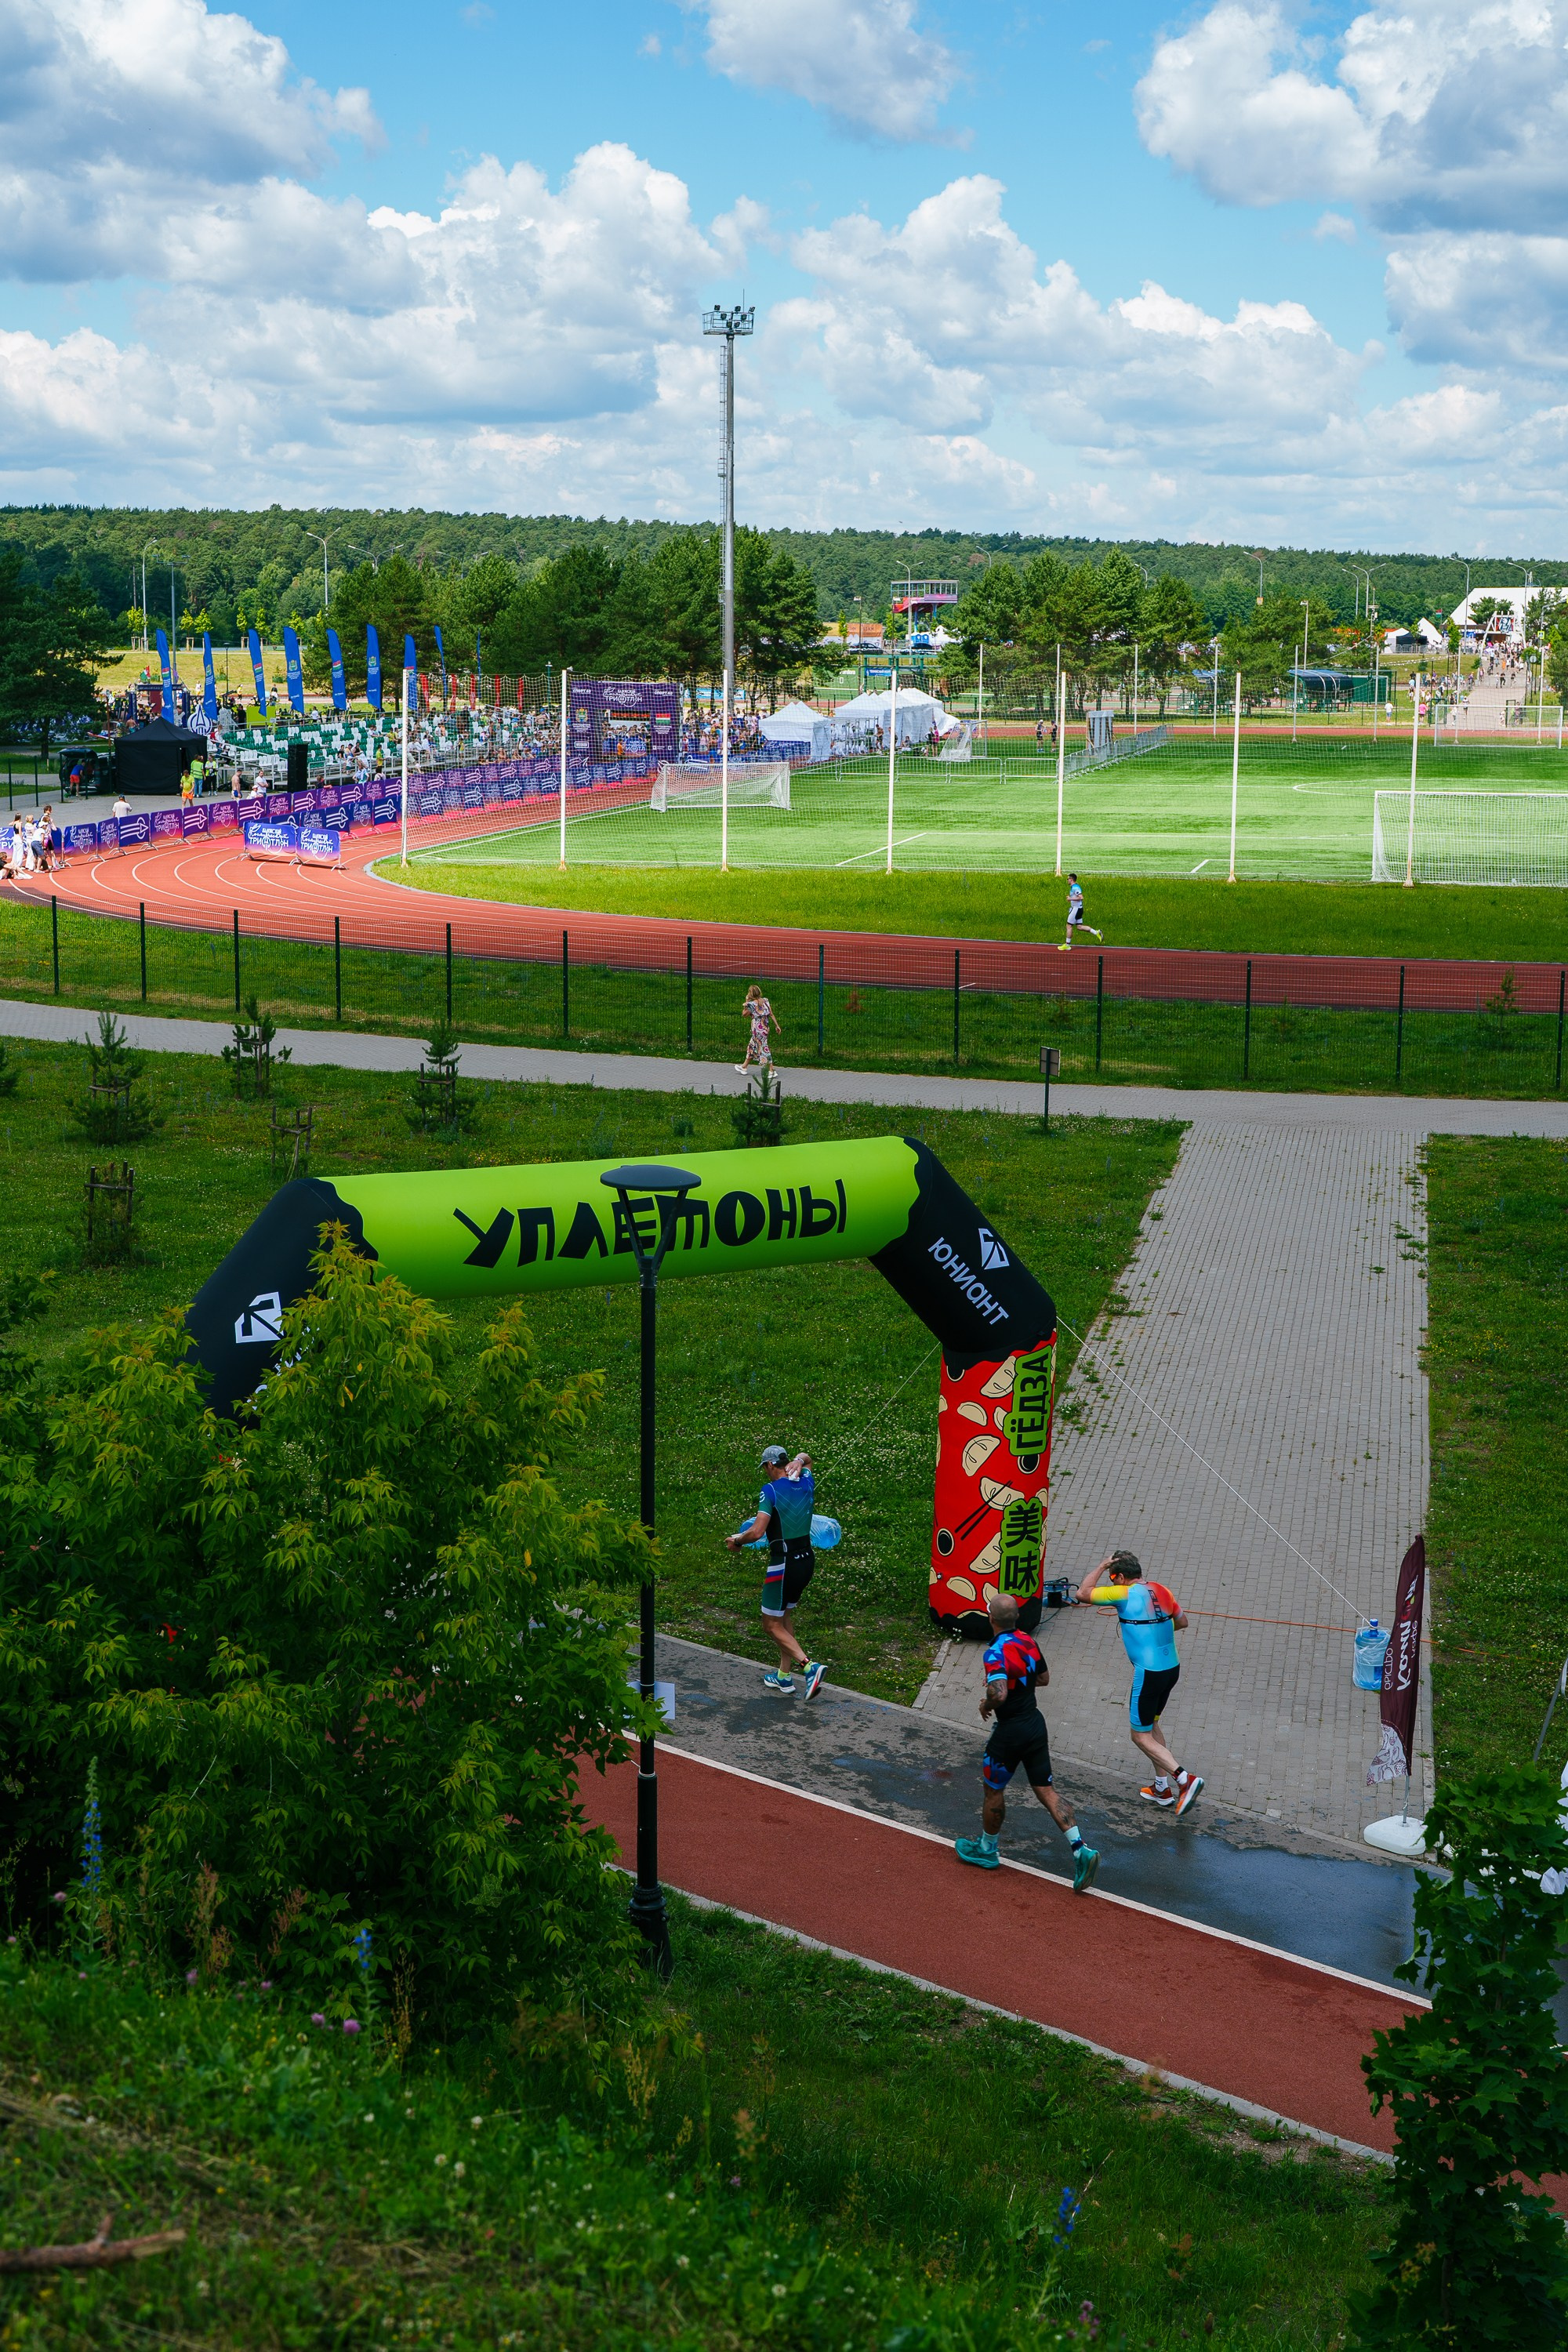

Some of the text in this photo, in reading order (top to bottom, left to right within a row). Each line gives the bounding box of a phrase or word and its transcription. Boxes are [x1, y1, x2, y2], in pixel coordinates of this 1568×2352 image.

[249, 837, 289, 849] ТРИАТЛОН
[1010, 1353, 1049, 1449] ГЁДЗА
[1004, 1502, 1039, 1593] 美味
